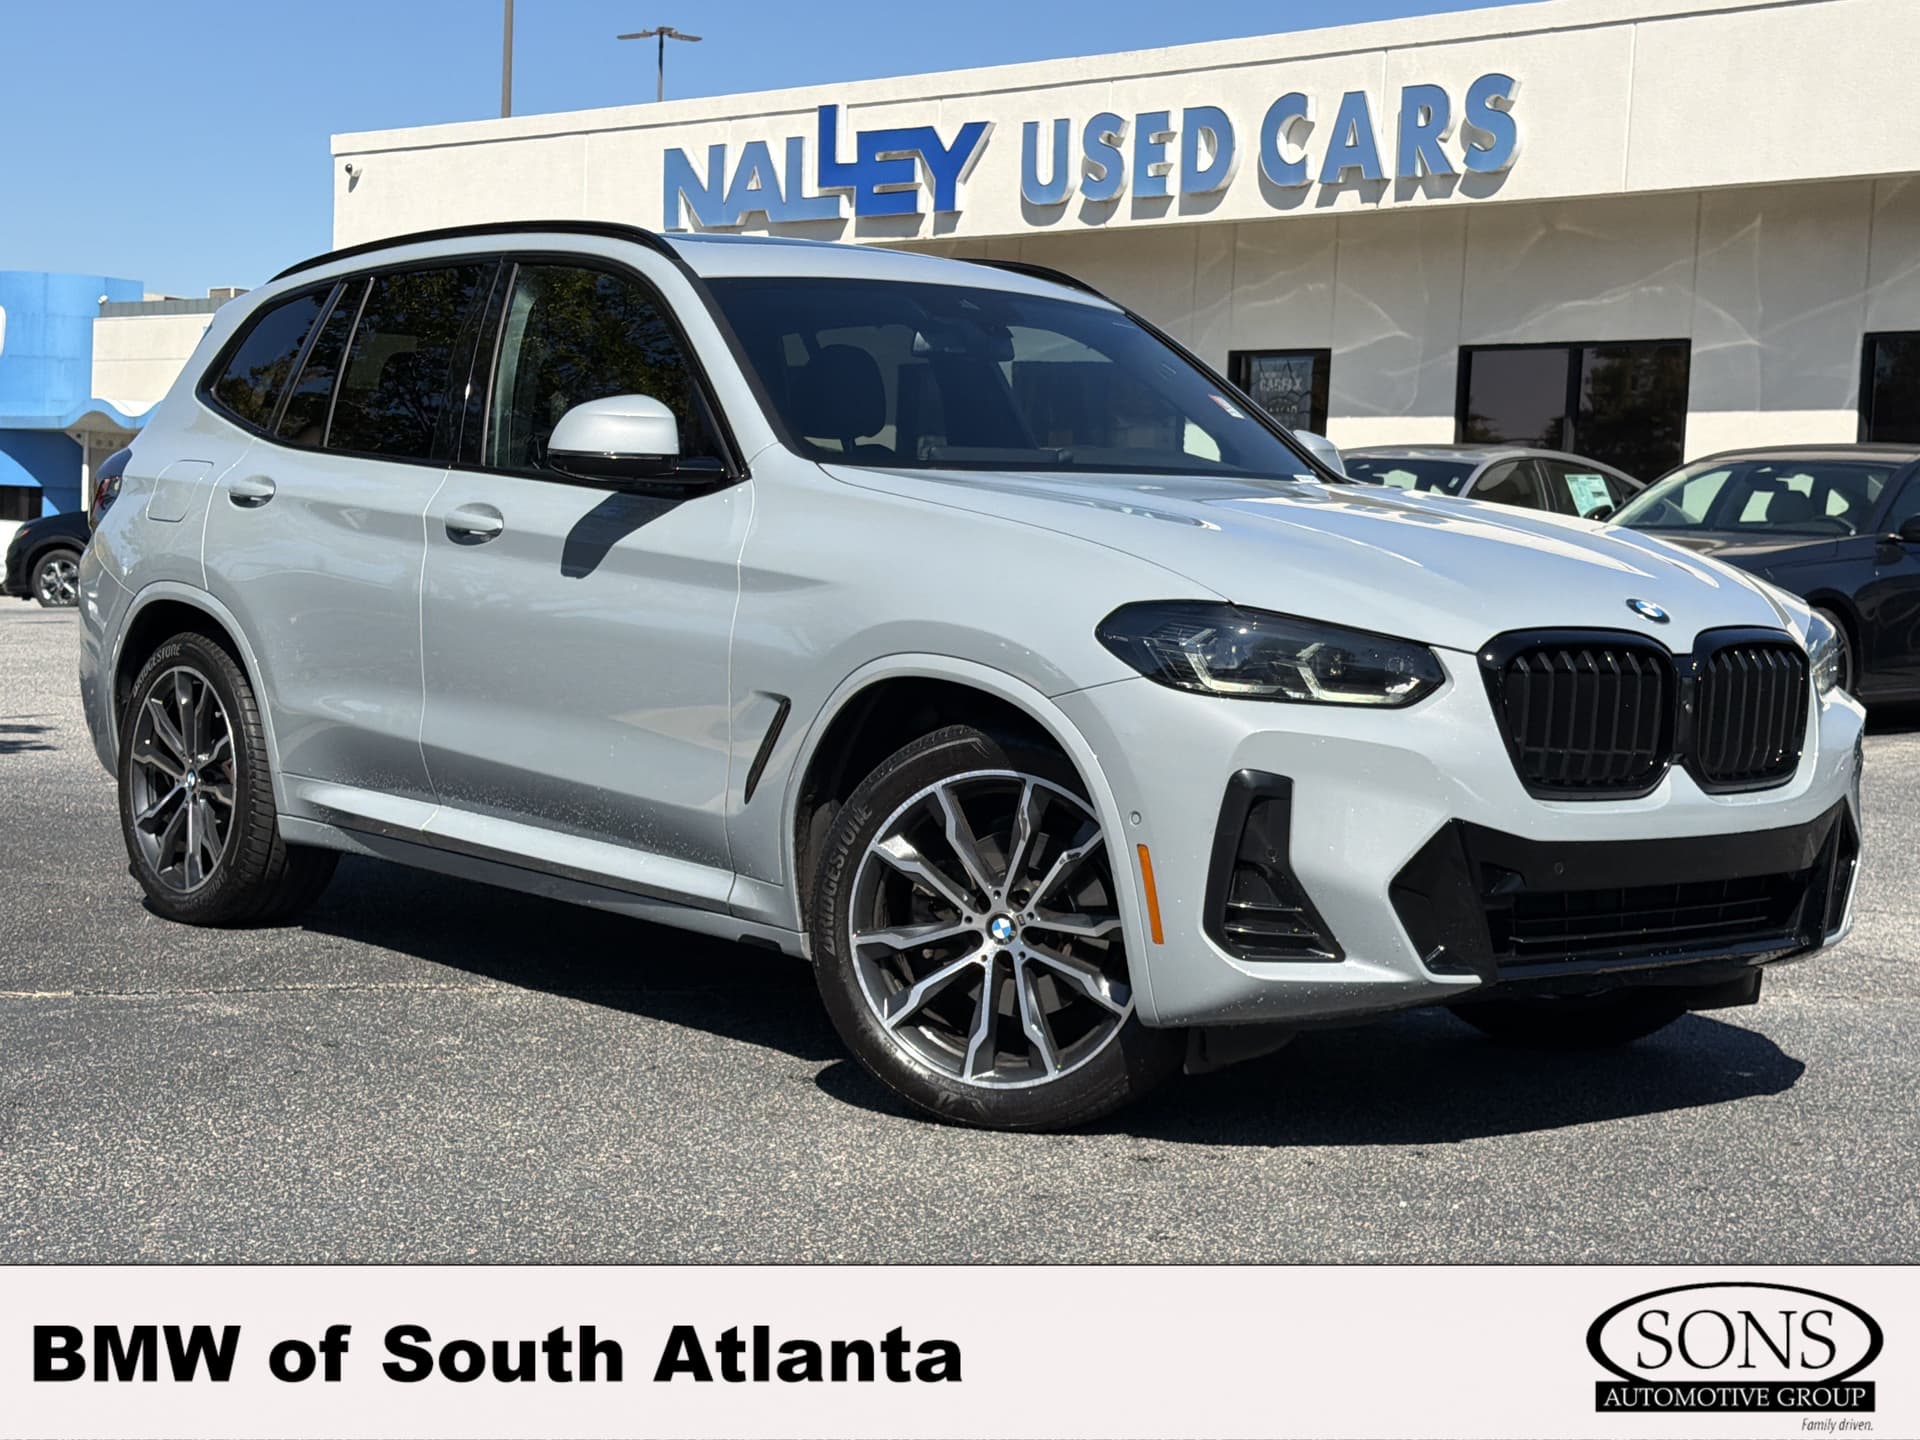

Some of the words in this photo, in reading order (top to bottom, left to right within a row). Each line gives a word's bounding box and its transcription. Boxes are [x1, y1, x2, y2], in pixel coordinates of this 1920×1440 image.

[663, 103, 994, 231] NALLEY
[1020, 104, 1240, 206] USED
[1259, 72, 1520, 188] CARS
